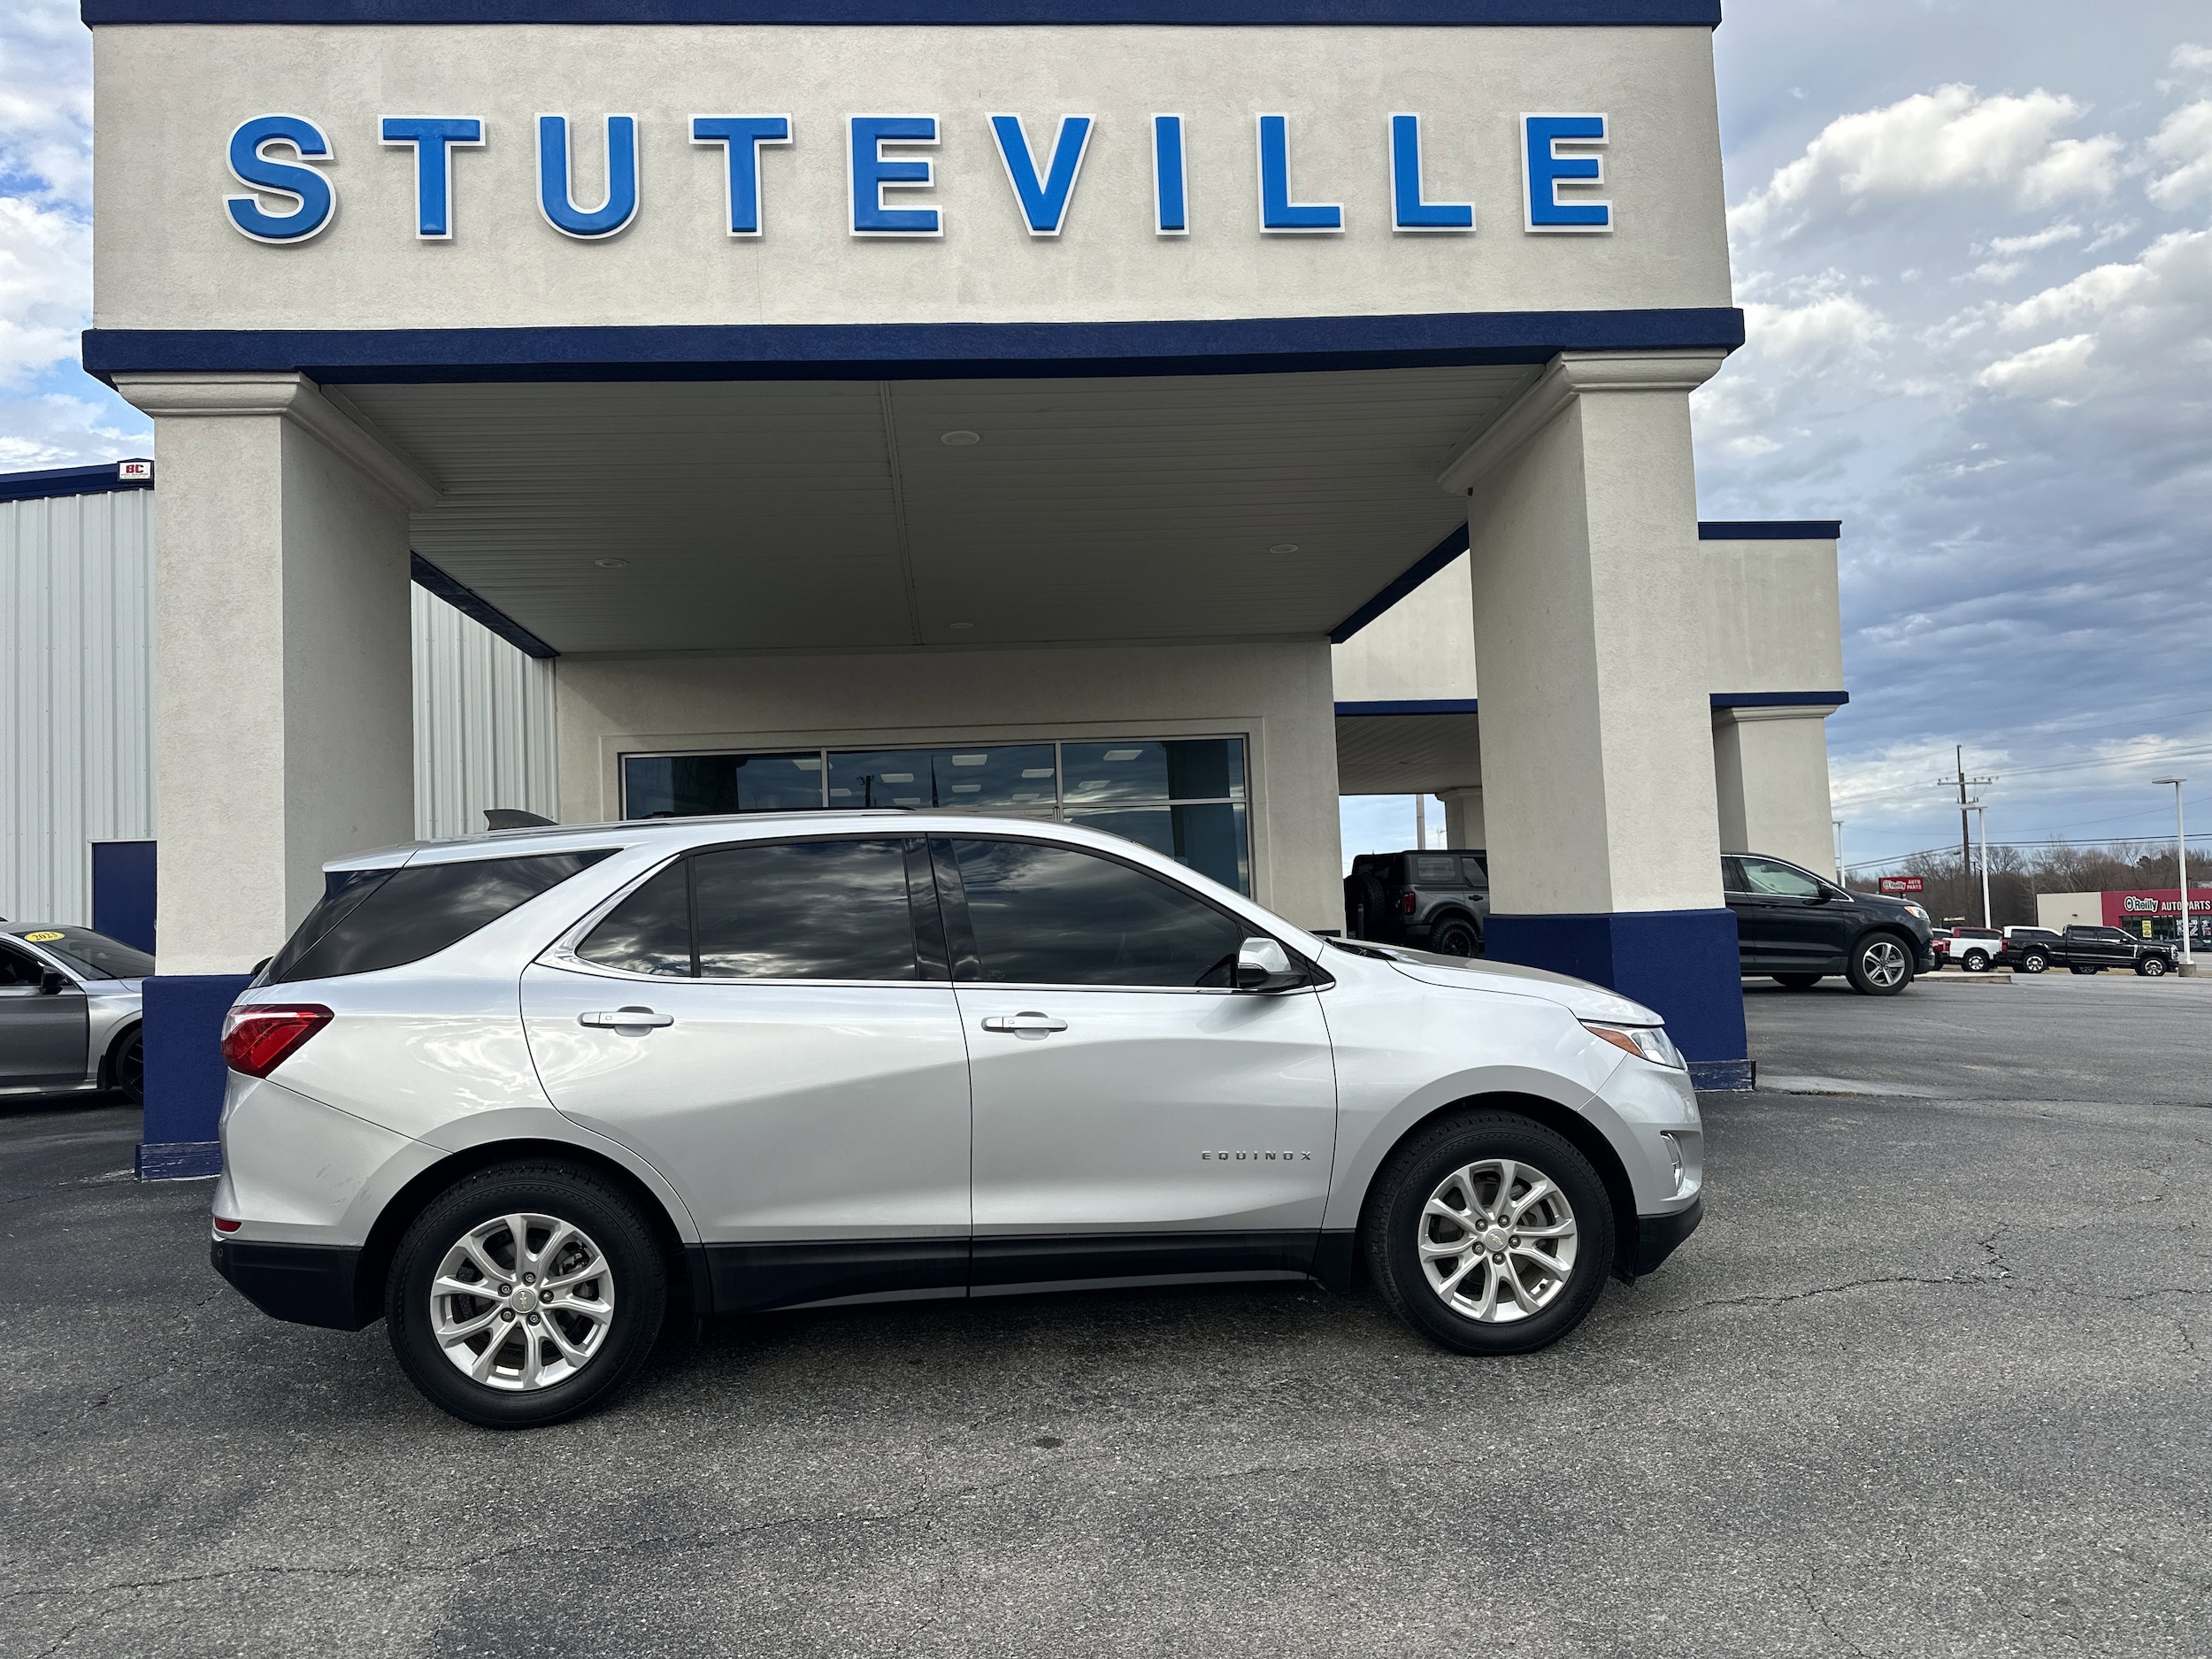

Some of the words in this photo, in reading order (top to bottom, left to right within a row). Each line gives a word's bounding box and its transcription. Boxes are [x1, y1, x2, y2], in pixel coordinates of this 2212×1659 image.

[222, 111, 1614, 244] STUTEVILLE
[126, 465, 144, 473] BC
[2124, 895, 2158, 912] O'Reilly
[2187, 900, 2211, 910] ARTS
[32, 932, 58, 941] 2023
[1202, 1150, 1312, 1161] EQUINOX
